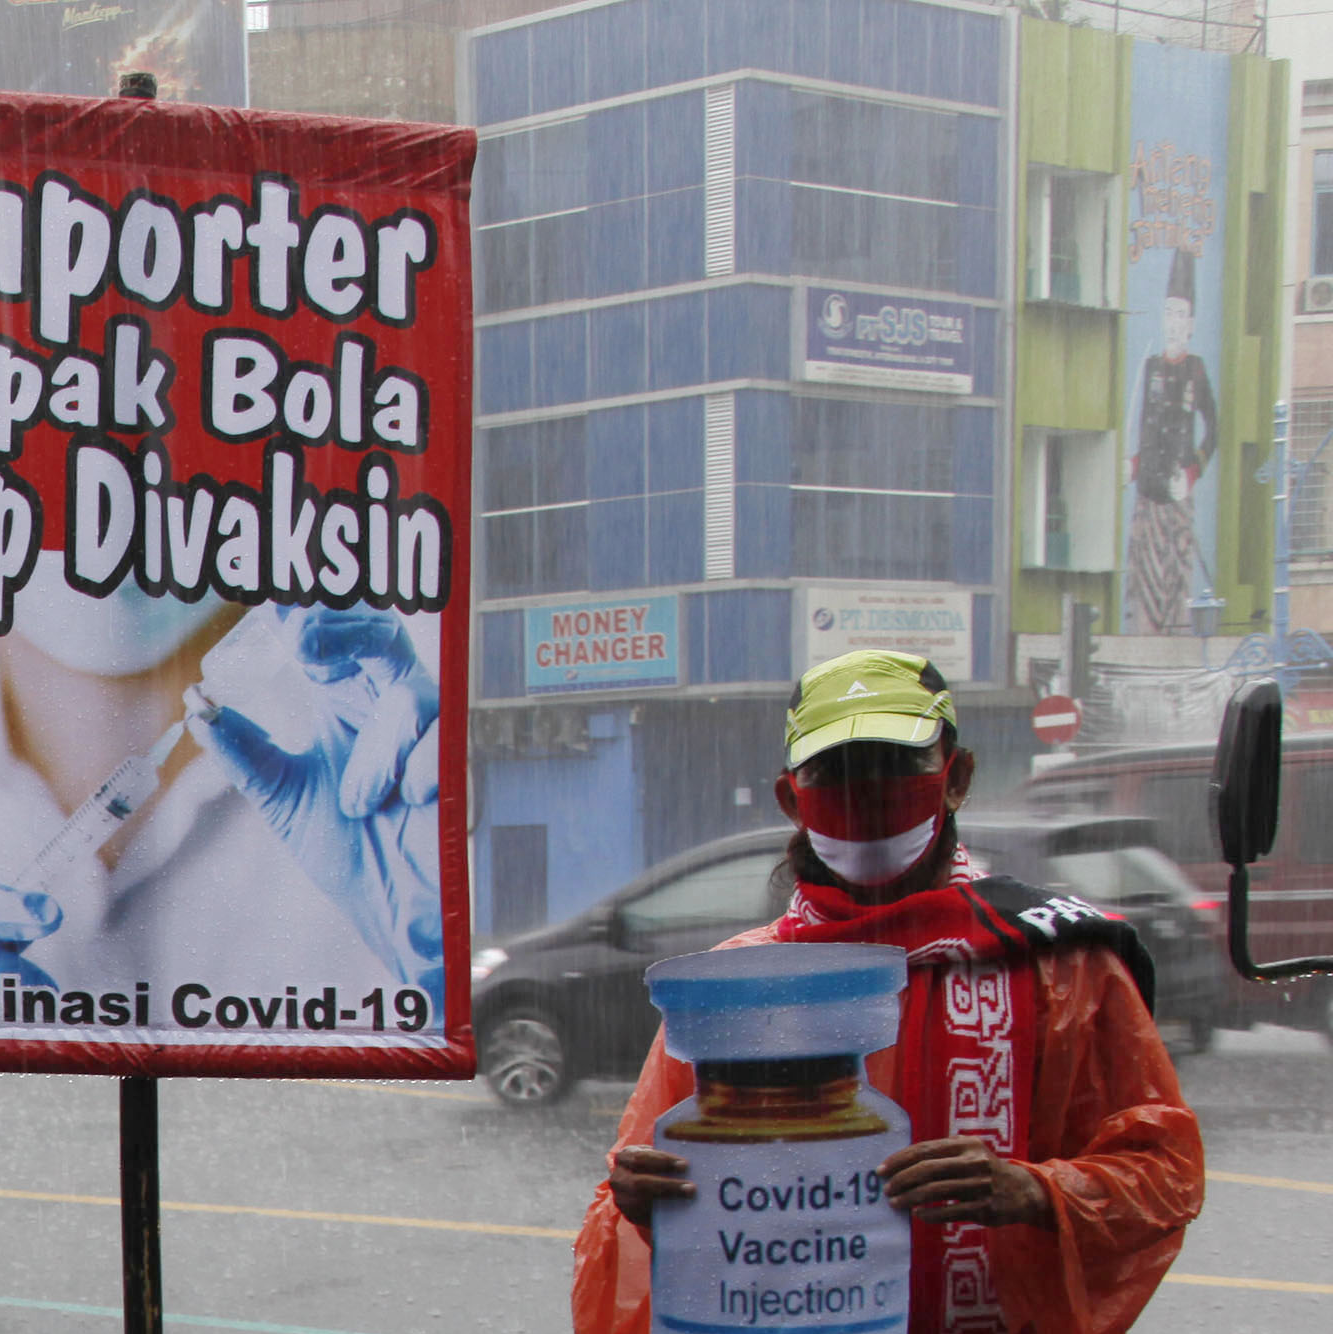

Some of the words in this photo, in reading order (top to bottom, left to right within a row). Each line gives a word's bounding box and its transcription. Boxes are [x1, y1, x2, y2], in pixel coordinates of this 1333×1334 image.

[878, 305, 929, 346] SJS
[207, 331, 422, 448] Bola
[71, 444, 446, 604] Divaksin
[552, 605, 650, 638] MONEY
[535, 633, 668, 668] CHANGER
[172, 981, 430, 1033] Covid-19
[718, 1168, 883, 1213] Covid-19
[717, 1228, 868, 1266] Vaccine
[719, 1279, 866, 1326] Injection
